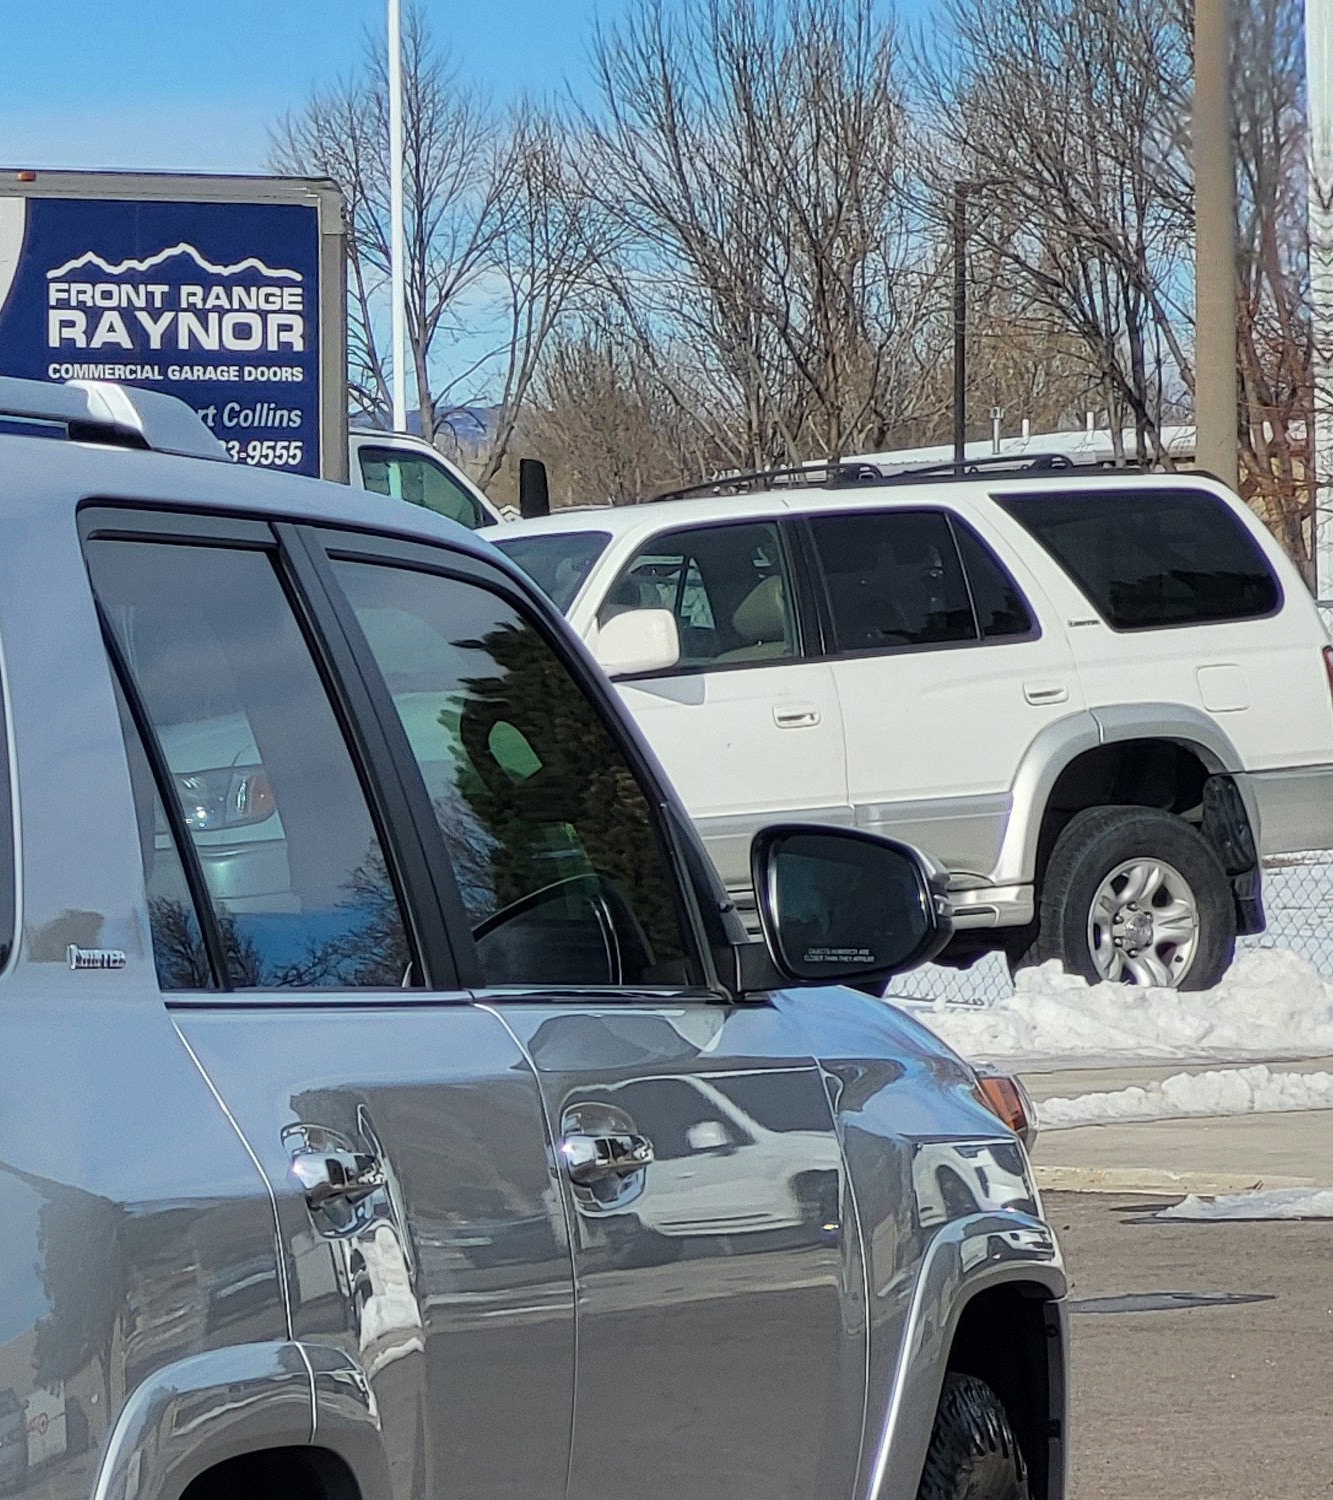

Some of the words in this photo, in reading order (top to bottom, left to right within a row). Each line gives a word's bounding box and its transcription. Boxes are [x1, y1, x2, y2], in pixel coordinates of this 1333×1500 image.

[48, 282, 170, 309] FRONT
[179, 284, 304, 311] RANGE
[47, 309, 305, 352] RAYNOR
[47, 363, 164, 380] COMMERCIAL
[167, 365, 239, 381] GARAGE
[243, 366, 304, 382] DOORS
[222, 401, 303, 428] Collins
